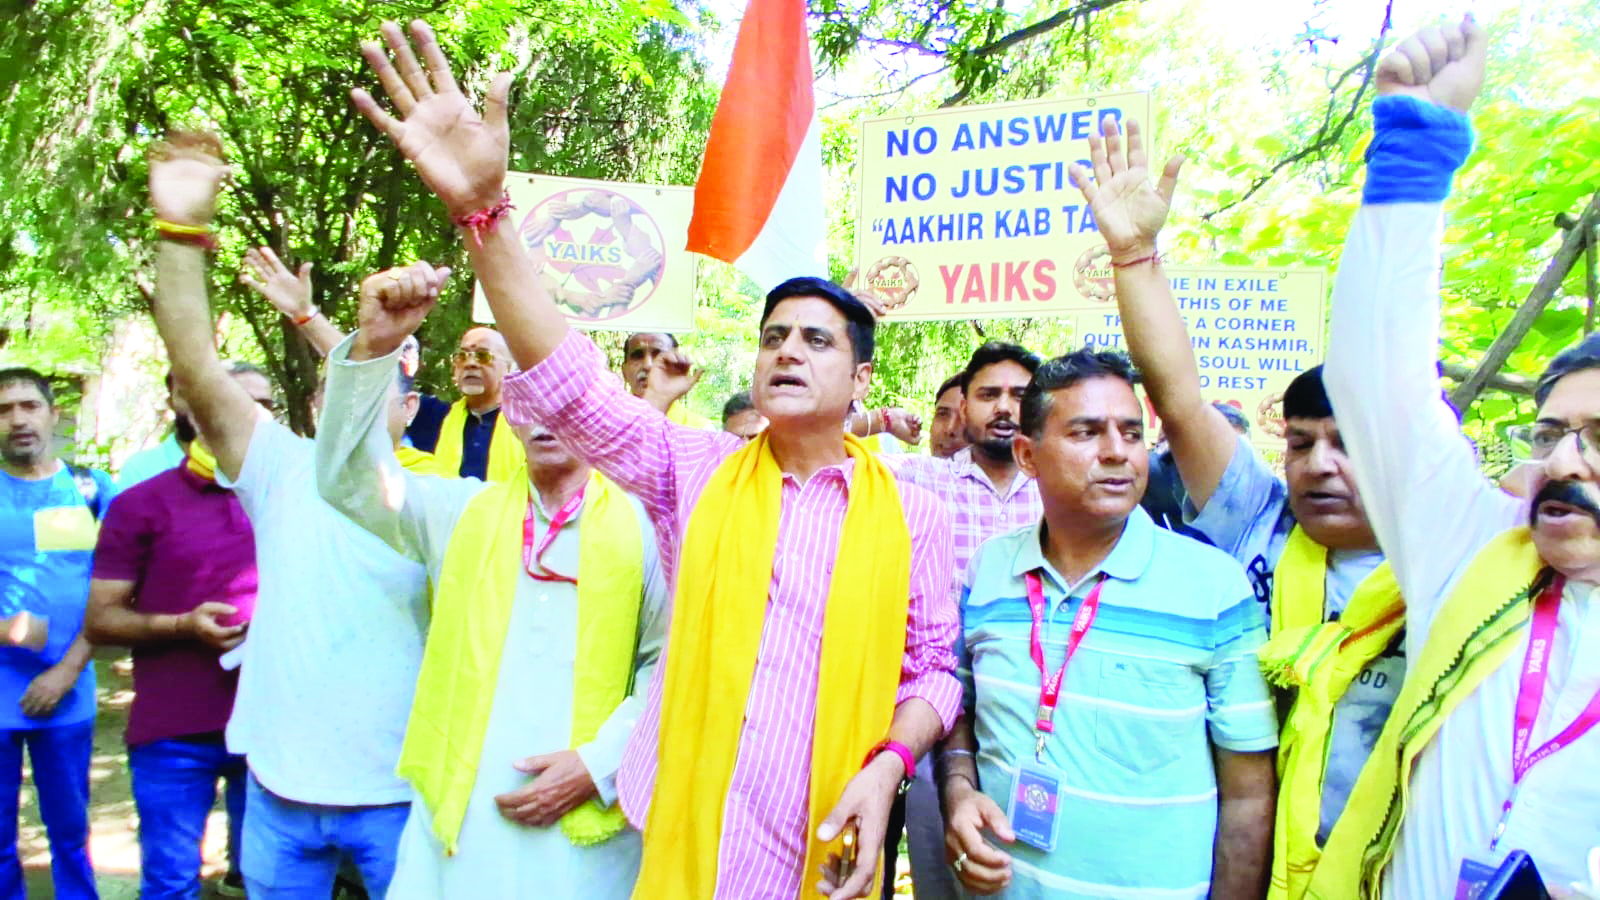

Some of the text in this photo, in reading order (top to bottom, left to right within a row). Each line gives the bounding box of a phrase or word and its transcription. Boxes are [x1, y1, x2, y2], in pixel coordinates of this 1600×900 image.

[886, 107, 1123, 158] NO ANSWER
[885, 159, 1096, 204] NO JUSTIC
[994, 207, 1051, 239] KAB
[1062, 203, 1099, 234] TA
[547, 241, 622, 262] YAIKS
[939, 259, 1057, 304] YAIKS
[1086, 269, 1112, 278] YAIK
[1168, 277, 1279, 292] IE IN EXILE
[1178, 297, 1288, 312] THIS OF ME
[1195, 317, 1207, 330] A
[1214, 317, 1296, 332] CORNER
[1084, 333, 1314, 355] OUT IN KASHMIR,
[1199, 355, 1305, 372] SOUL WILL
[1218, 376, 1268, 390] REST
[1074, 604, 1094, 633] YAIKS
[1526, 638, 1547, 674] YAIKS
